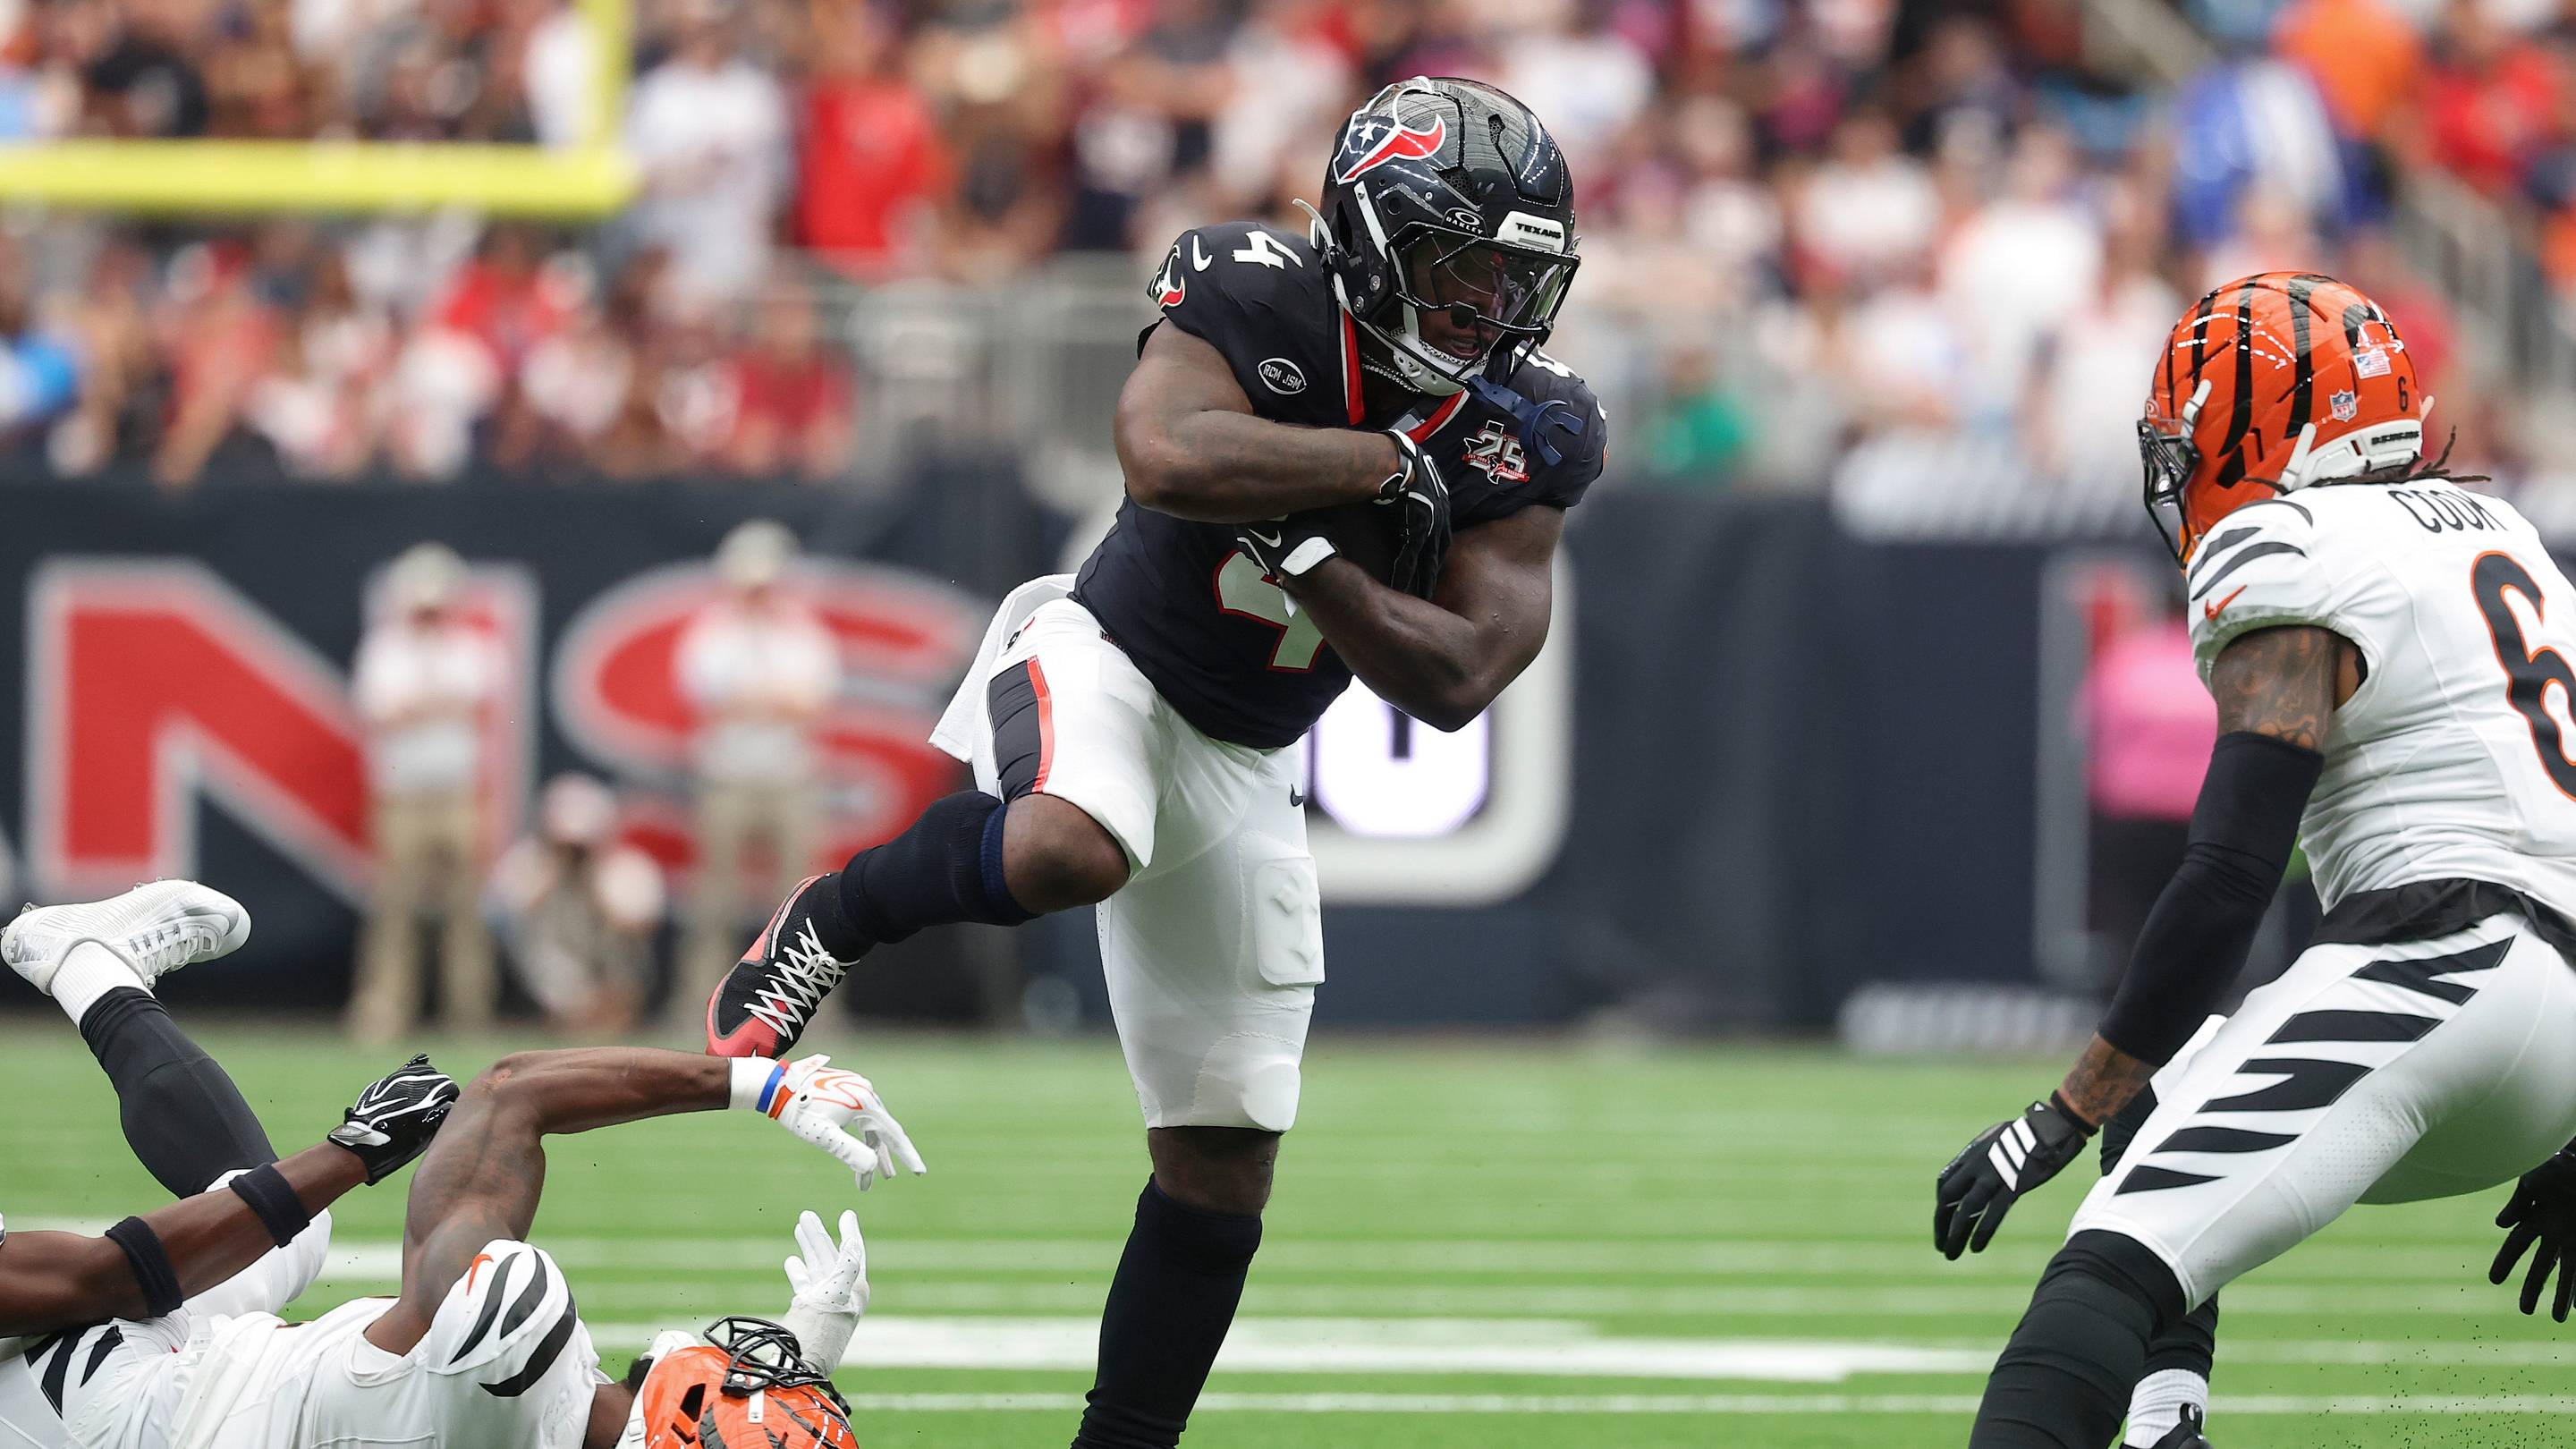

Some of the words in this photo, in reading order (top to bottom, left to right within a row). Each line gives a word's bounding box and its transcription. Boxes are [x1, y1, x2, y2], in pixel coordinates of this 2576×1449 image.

[1445, 216, 1484, 235] OAKLEY
[1515, 222, 1563, 239] TEXANS
[1232, 231, 1303, 269] 4
[1263, 363, 1283, 381] RCM
[1282, 373, 1302, 390] JSM
[2398, 376, 2408, 411] 6
[1473, 429, 1526, 473] 25
[2387, 489, 2509, 533] COOK
[2470, 550, 2576, 802] 6
